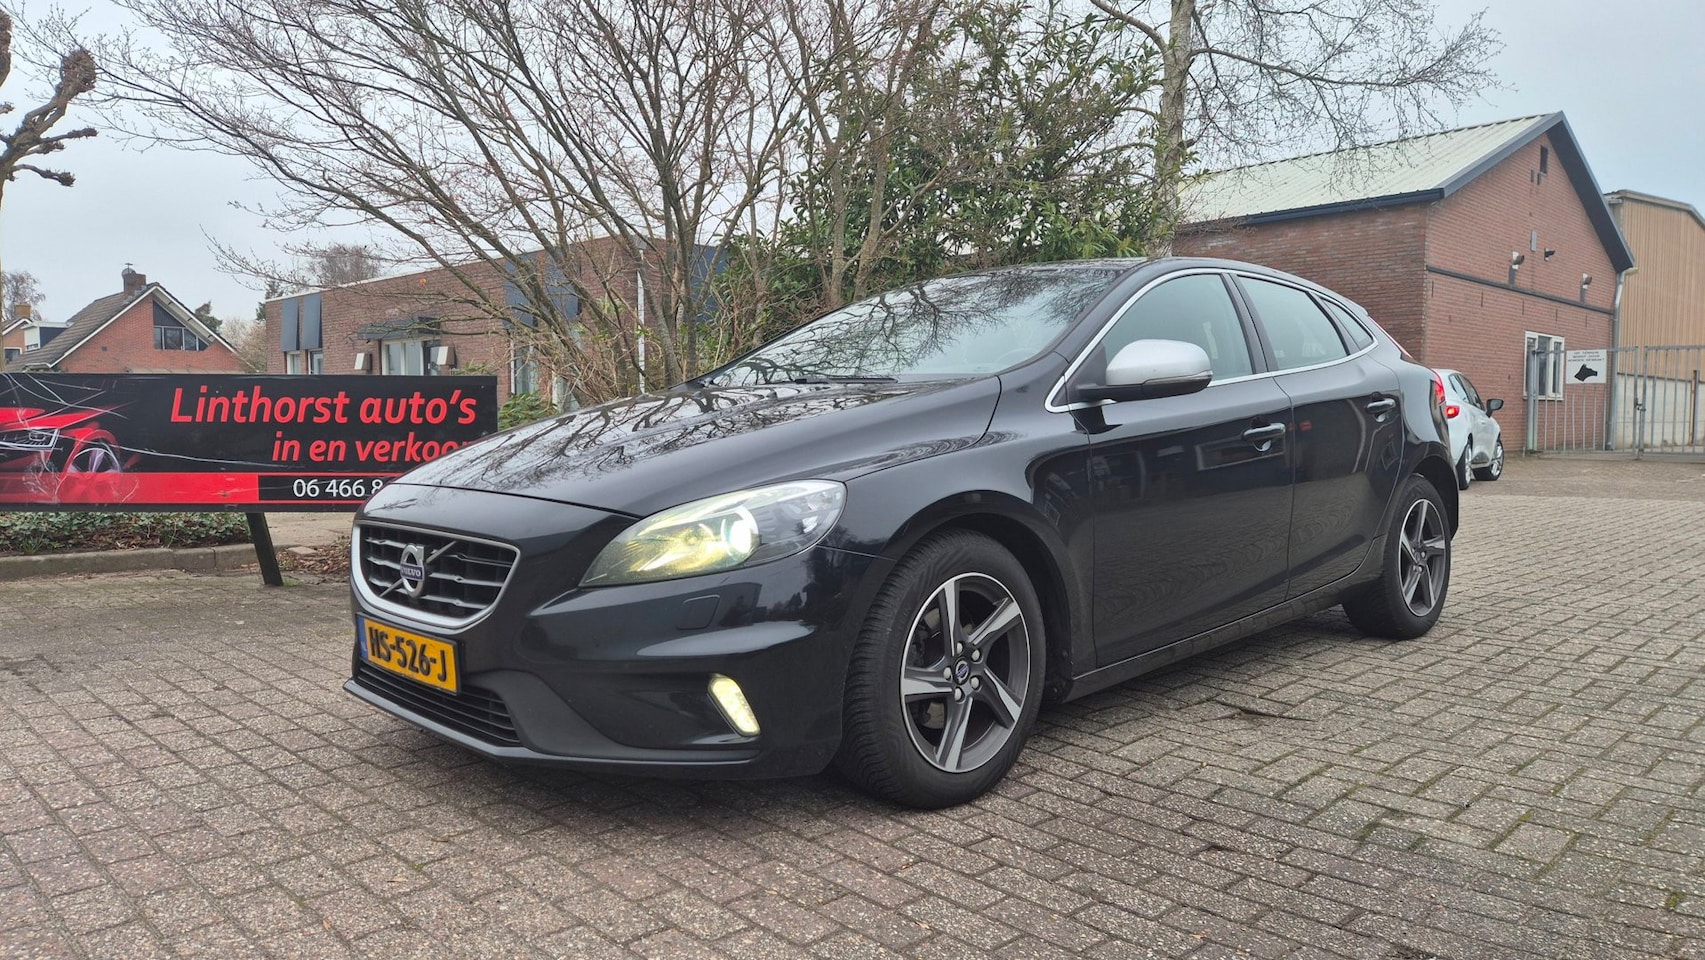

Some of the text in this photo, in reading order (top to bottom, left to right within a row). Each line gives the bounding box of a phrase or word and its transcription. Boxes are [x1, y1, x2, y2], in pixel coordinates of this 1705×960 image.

[170, 385, 477, 424] Linthorst auto's
[272, 431, 472, 462] in en verkoo
[293, 478, 320, 497] 06
[325, 478, 366, 498] 466
[368, 627, 447, 682] HS-526-J
